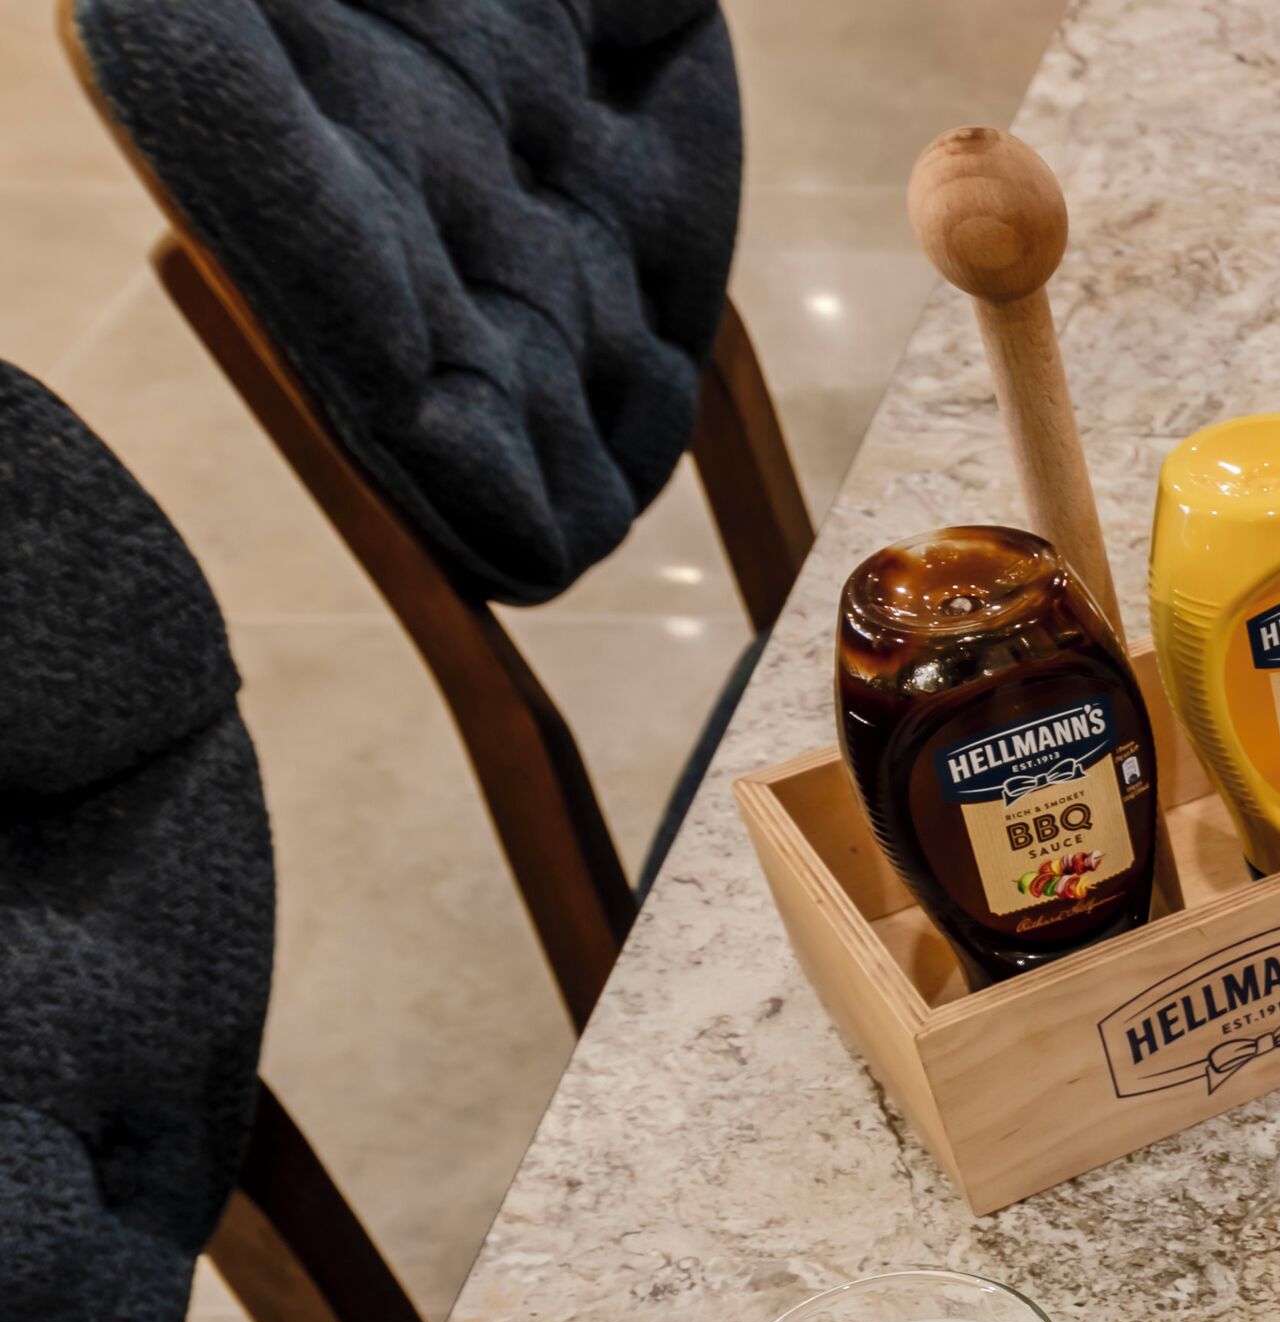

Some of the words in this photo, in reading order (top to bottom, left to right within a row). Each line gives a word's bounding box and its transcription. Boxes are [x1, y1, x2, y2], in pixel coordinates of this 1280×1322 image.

[947, 704, 1106, 784] HELLMANN'S
[1011, 751, 1061, 773] EST.1913
[1005, 808, 1031, 821] RICH
[1044, 790, 1085, 810] SMOKEY
[1005, 803, 1093, 851] BBQ
[1028, 833, 1084, 860] SAUCE
